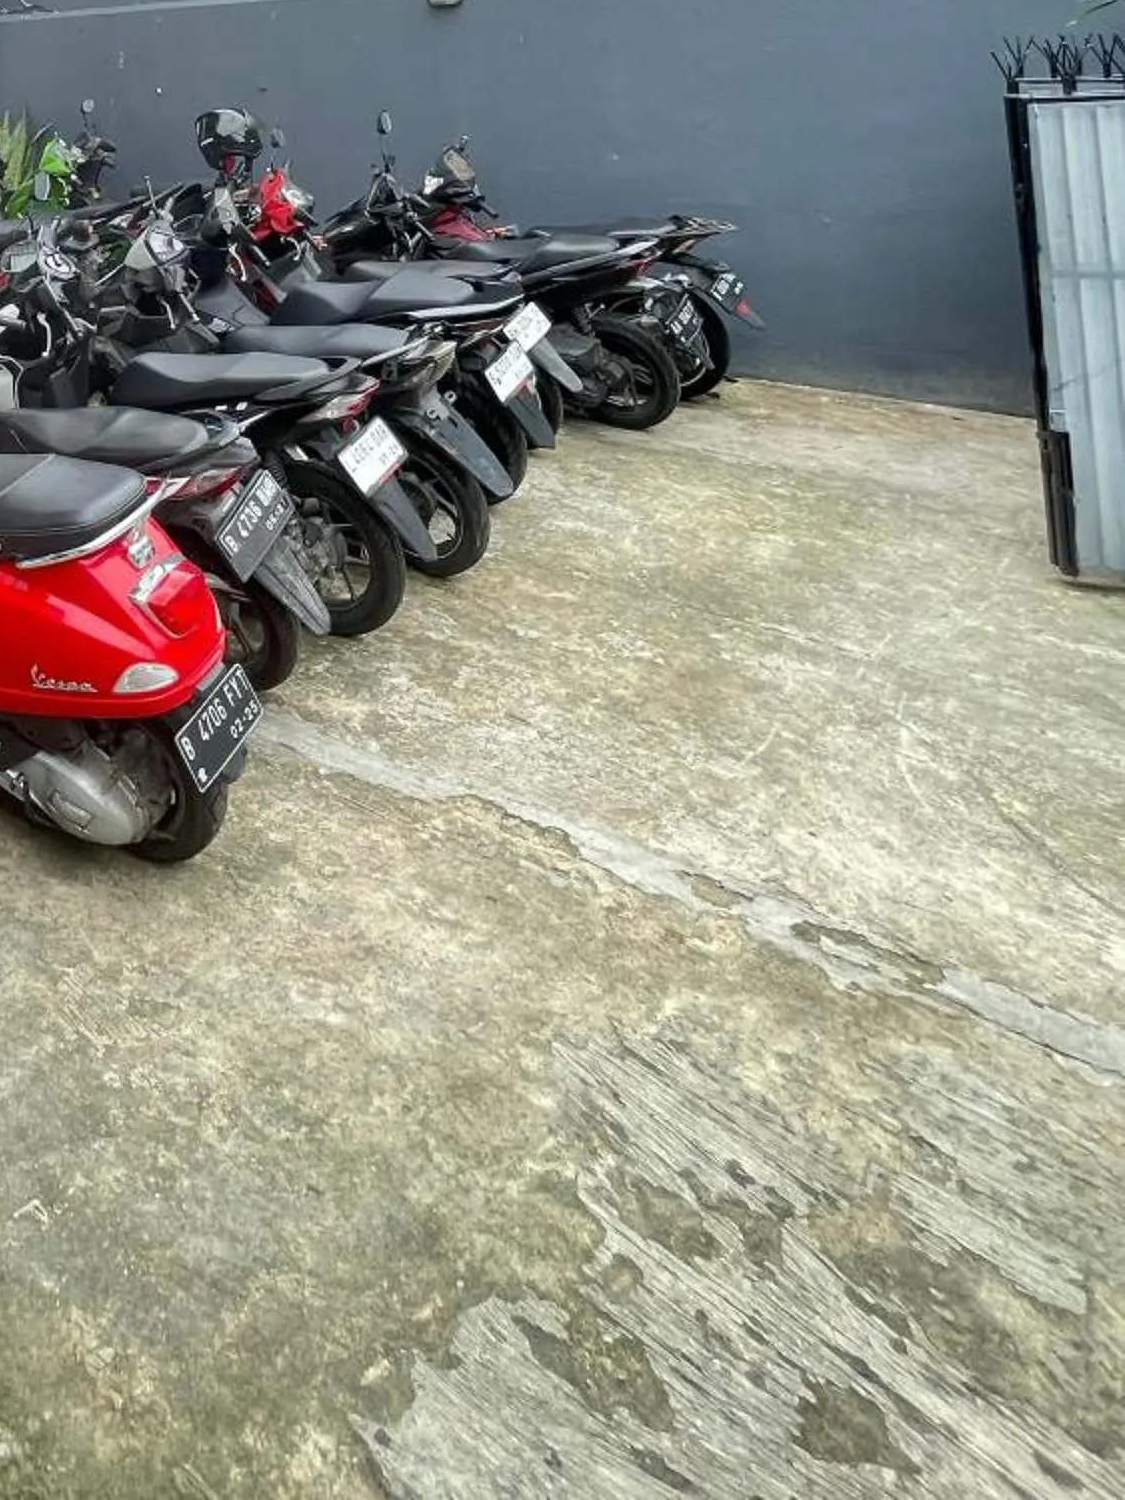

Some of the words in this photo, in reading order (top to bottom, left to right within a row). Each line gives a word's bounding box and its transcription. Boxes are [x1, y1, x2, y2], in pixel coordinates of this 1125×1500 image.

[224, 535, 239, 553] B
[180, 735, 196, 761] B
[197, 697, 228, 741] 4706
[222, 669, 249, 707] FYT
